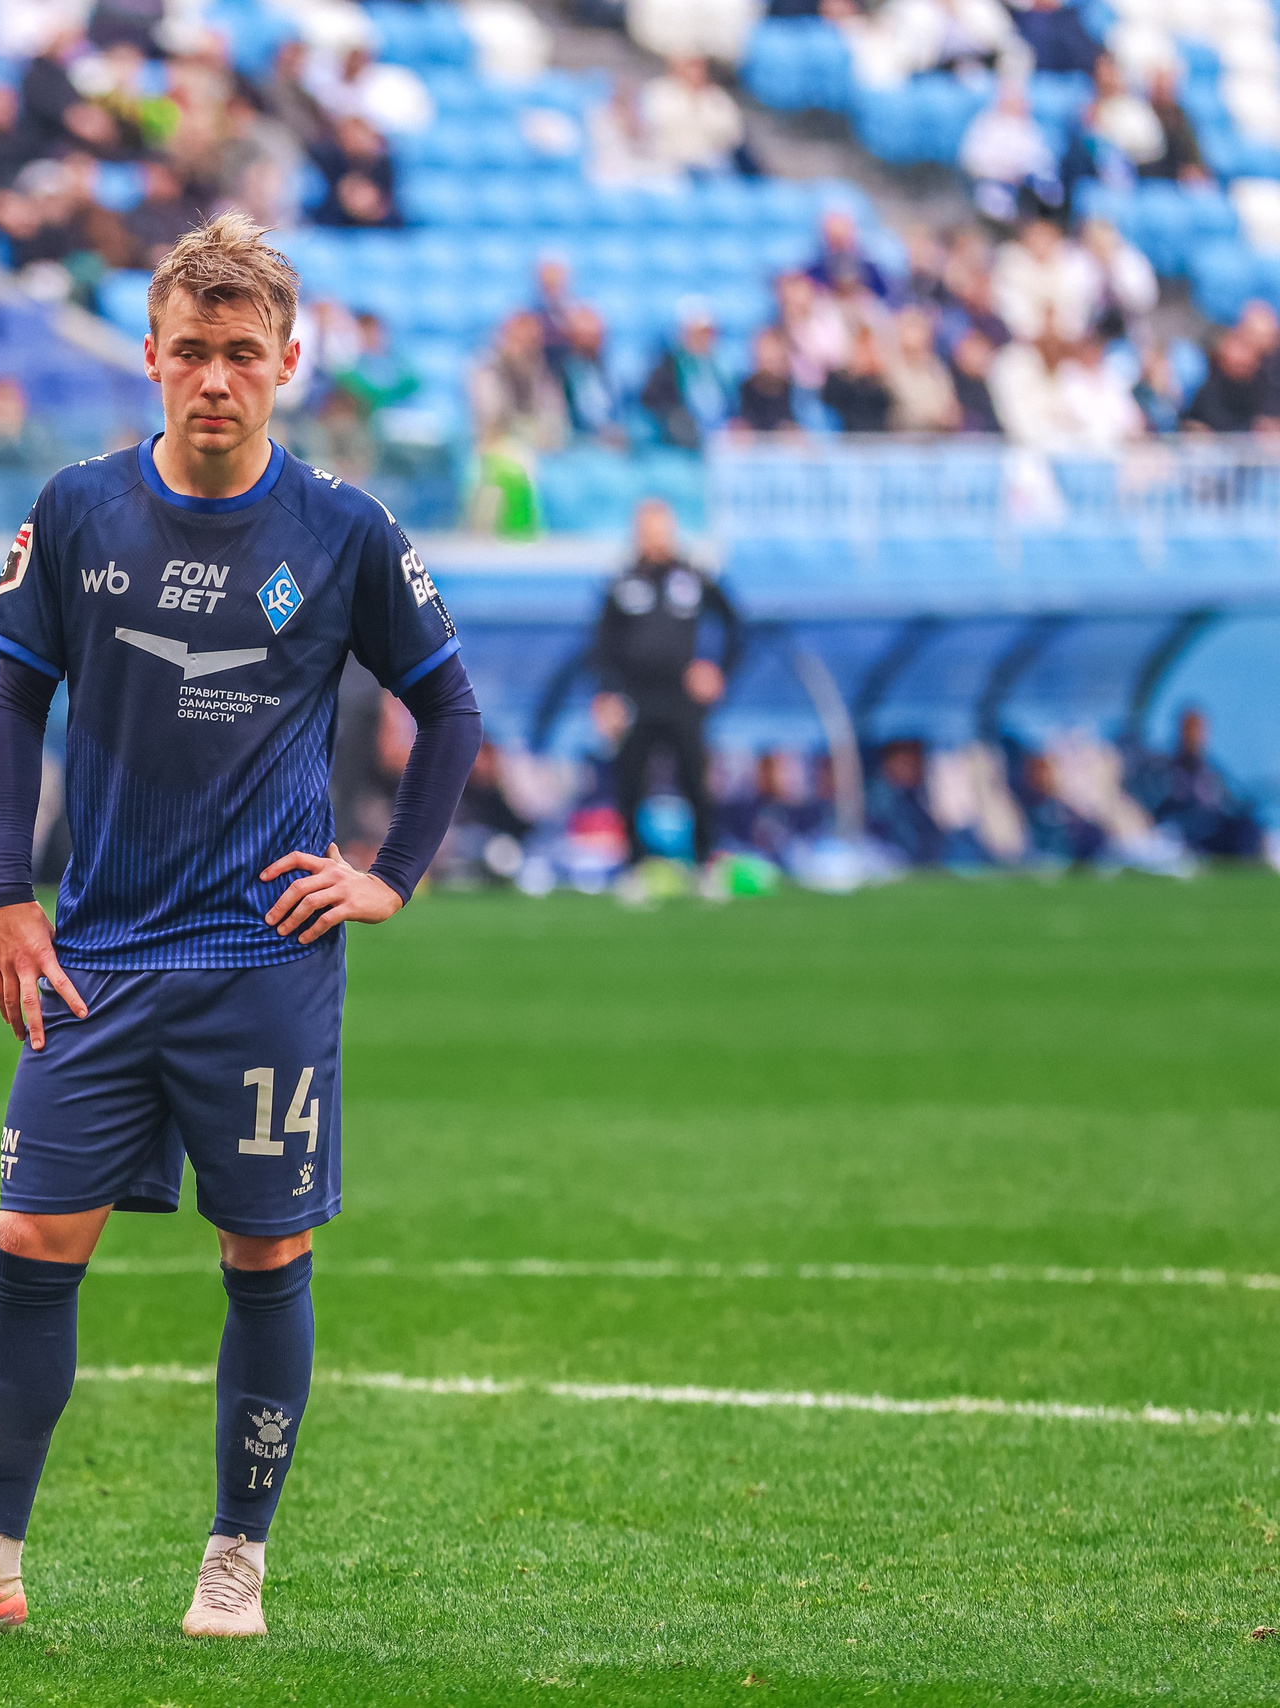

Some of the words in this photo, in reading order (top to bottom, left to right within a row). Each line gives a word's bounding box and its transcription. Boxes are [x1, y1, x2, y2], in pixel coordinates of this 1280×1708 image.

[81, 561, 130, 595] wb
[160, 559, 230, 589] FON
[401, 547, 425, 584] FO
[157, 585, 227, 614] BET
[410, 572, 439, 608] BE
[178, 697, 253, 714] САМАРСКОЙ
[179, 686, 281, 706] ПРАВИТЕЛЬСТВО
[177, 709, 235, 723] ОБЛАСТИ
[238, 1066, 320, 1156] 14
[0, 1126, 21, 1154] ON
[0, 1154, 19, 1180] ET
[244, 1436, 288, 1459] KELME
[247, 1465, 274, 1490] 14
